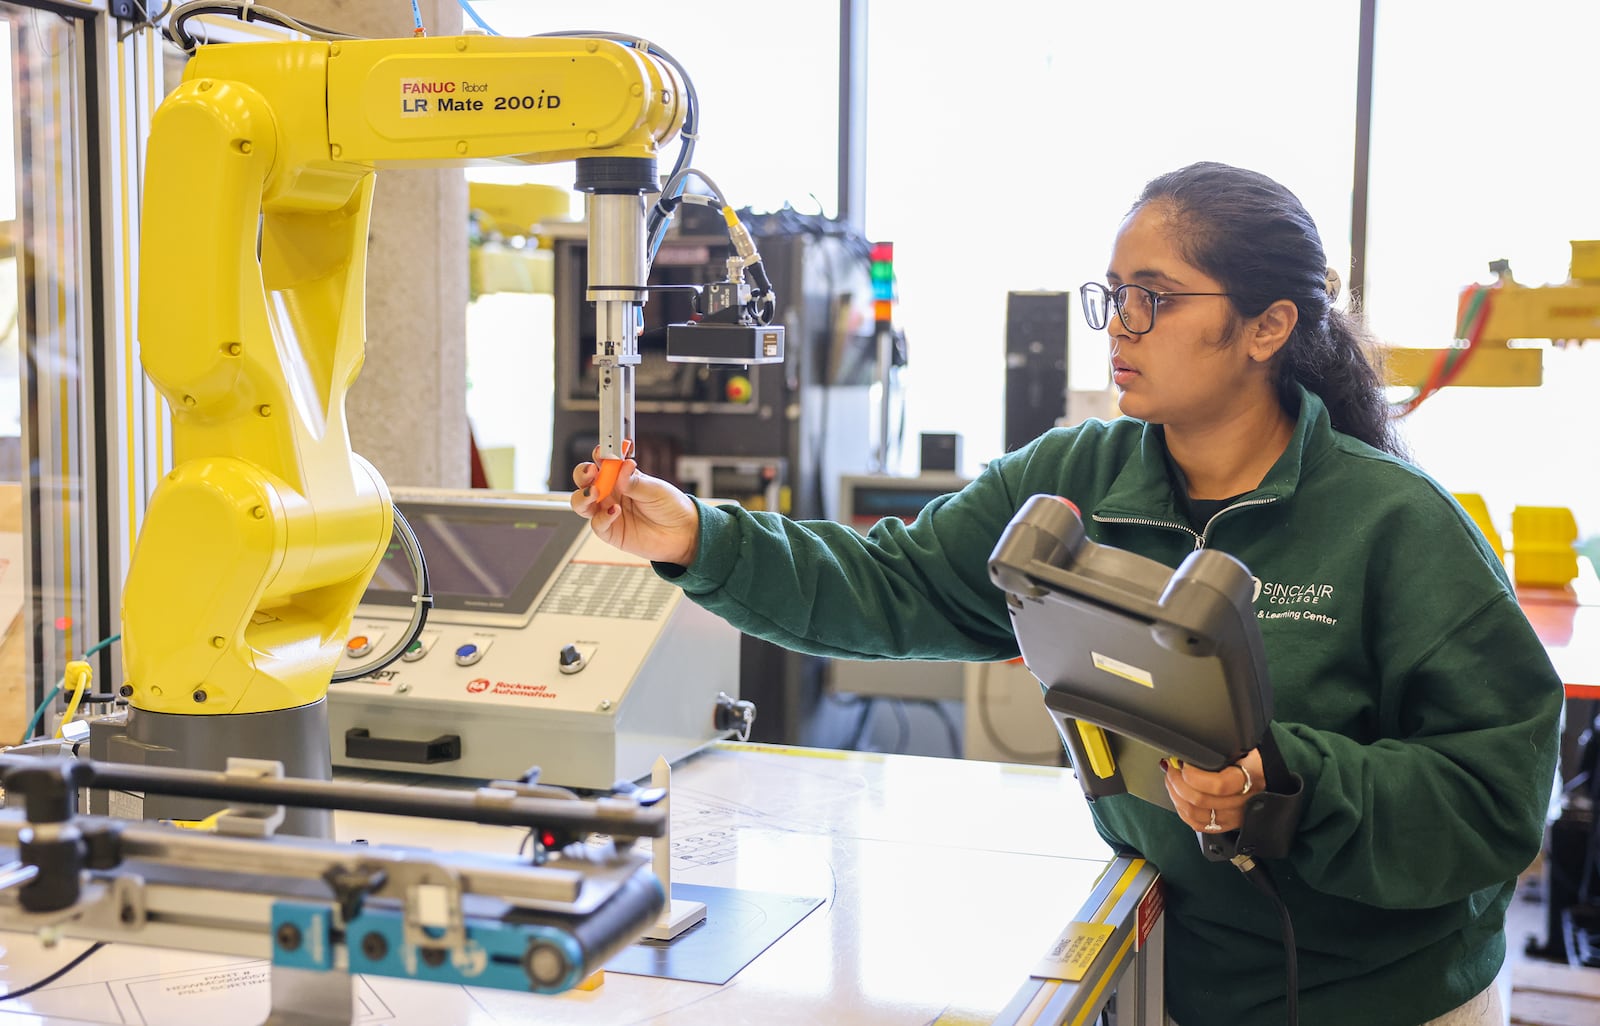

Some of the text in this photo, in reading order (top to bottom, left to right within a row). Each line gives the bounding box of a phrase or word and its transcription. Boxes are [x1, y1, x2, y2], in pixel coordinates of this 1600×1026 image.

[402, 81, 488, 94] FANUC Robot
[403, 89, 561, 112] LR Mate 200iD
[1263, 582, 1334, 599] SINCLAIR
[1270, 596, 1320, 605] COLLEGE
[1257, 610, 1338, 625] & Learning Center
[491, 687, 557, 698] Automation
[496, 682, 547, 691] Rockwell
